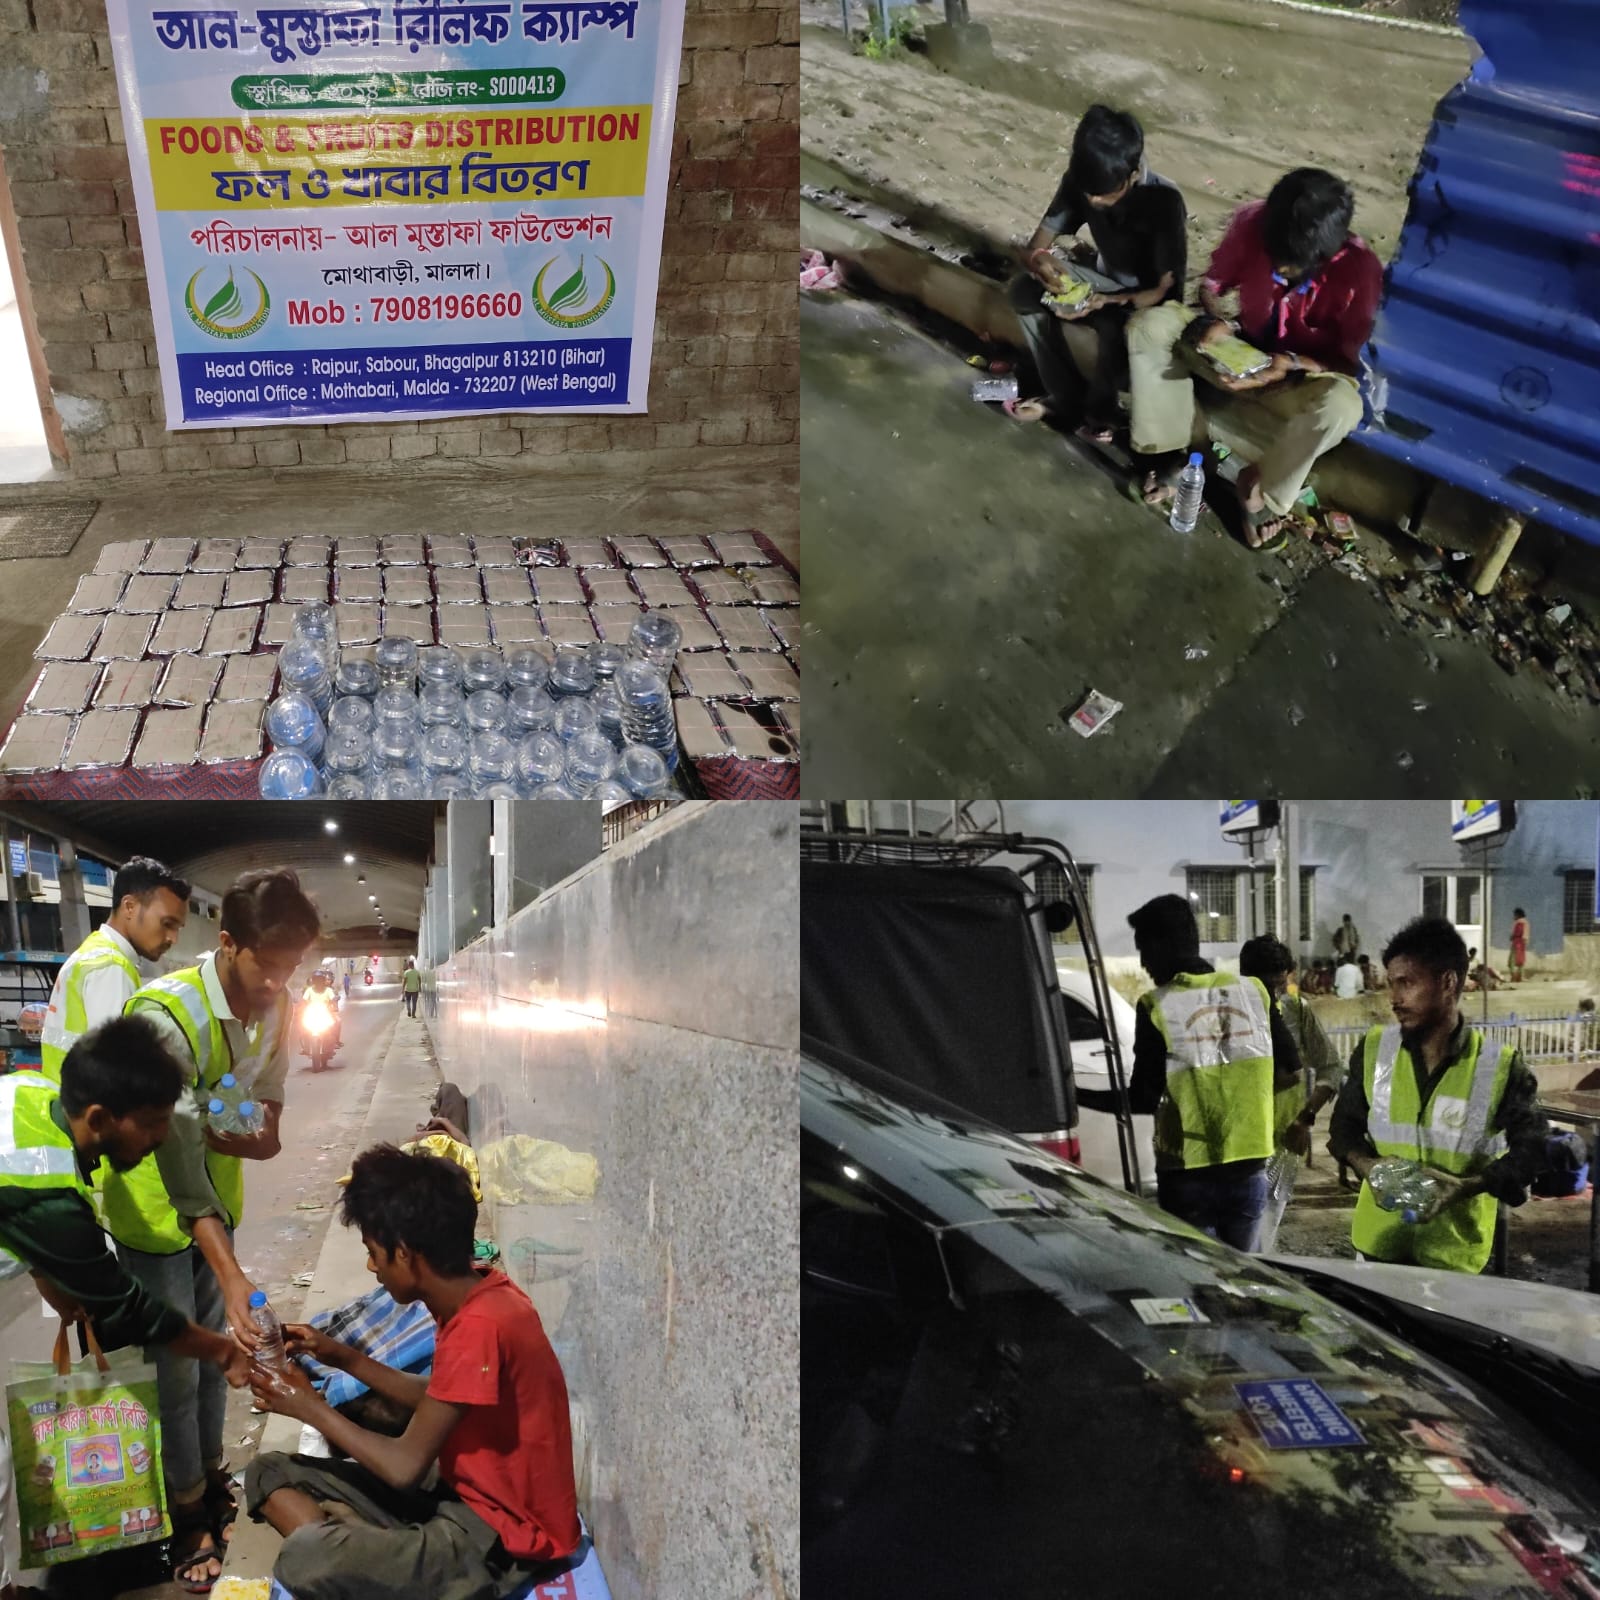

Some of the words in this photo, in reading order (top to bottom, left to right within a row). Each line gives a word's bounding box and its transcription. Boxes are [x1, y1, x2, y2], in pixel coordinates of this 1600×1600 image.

[522, 1, 638, 43] ক্যাম্প
[489, 75, 556, 96] S000413
[160, 125, 264, 154] FOODS
[275, 124, 296, 152] &
[306, 120, 414, 151] FRUITS
[425, 113, 640, 149] DISTRIBUTION
[211, 170, 291, 202] ফল
[302, 169, 331, 200] ও
[342, 165, 451, 200] খাবার
[459, 151, 590, 196] বিতরণ
[342, 222, 398, 249] আল
[404, 218, 482, 252] মুস্তাফা
[488, 211, 613, 245] ফাউন্ডেশন
[288, 299, 345, 325] Mob
[370, 292, 522, 323] 7908196660
[205, 361, 246, 378] Head
[249, 360, 294, 376] Office
[312, 358, 362, 378] Rajpur,
[366, 355, 420, 374] Sabour,
[424, 353, 499, 374] Bhagalpur
[503, 349, 556, 368] 813210
[561, 347, 605, 369] (Bihar)
[195, 386, 259, 408] Regional
[263, 384, 308, 401] Office
[321, 380, 399, 399] Mothabari,
[403, 379, 450, 396] Malda
[464, 376, 517, 393] 732207
[520, 374, 558, 395] (West
[562, 372, 616, 394] Bengal)
